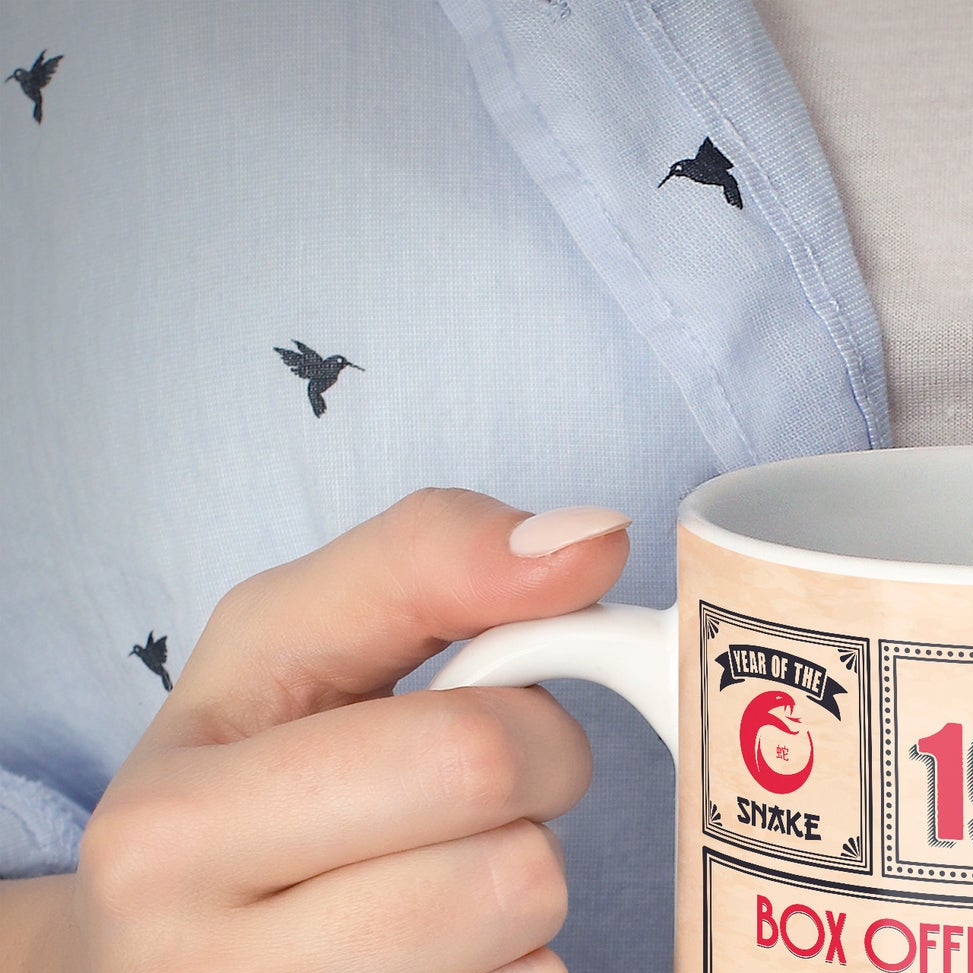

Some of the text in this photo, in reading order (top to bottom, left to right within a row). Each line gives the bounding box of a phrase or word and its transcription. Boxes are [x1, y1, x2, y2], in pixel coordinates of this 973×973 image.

[733, 650, 822, 693] YEAR OF THE
[737, 796, 822, 841] SNAKE
[757, 894, 847, 966] BOX
